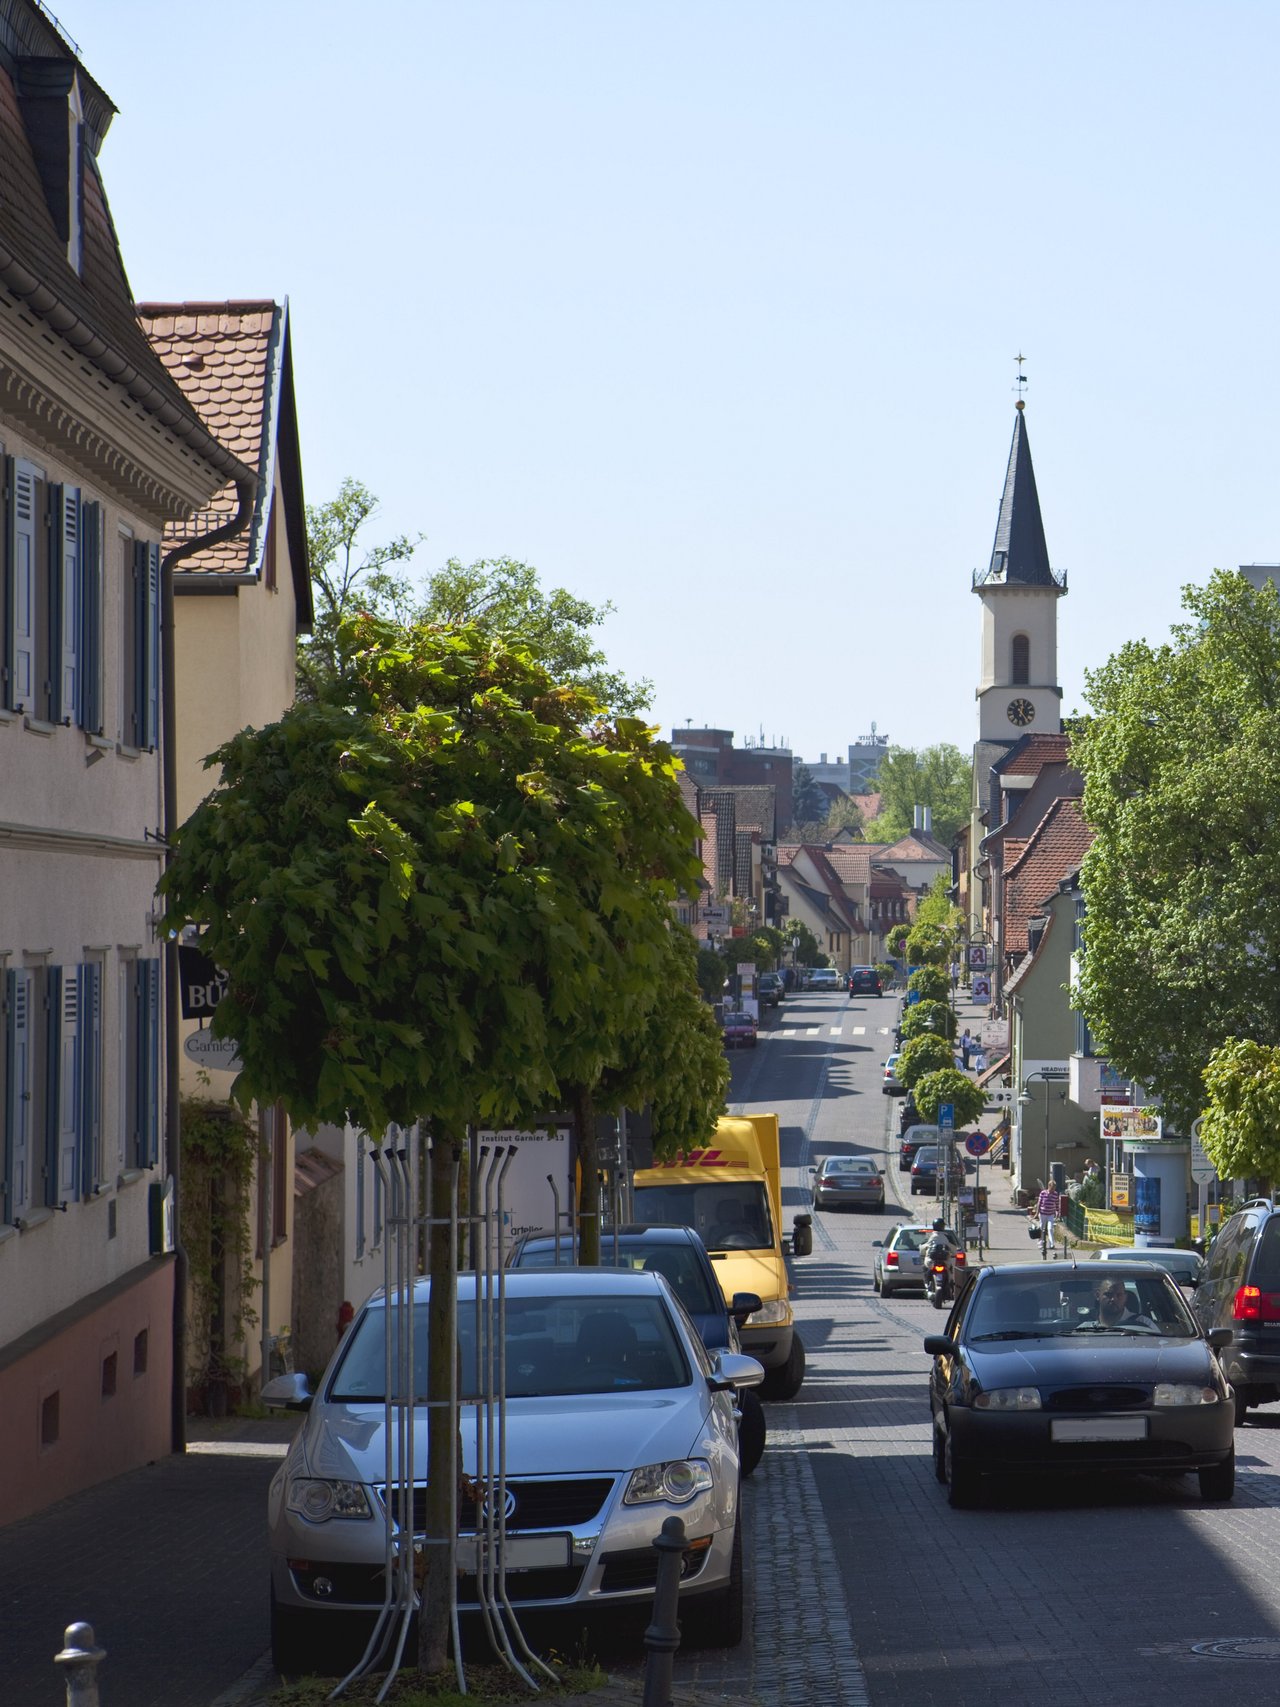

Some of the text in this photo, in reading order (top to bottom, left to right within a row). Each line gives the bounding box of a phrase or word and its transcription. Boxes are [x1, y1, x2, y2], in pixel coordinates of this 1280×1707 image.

[186, 1039, 239, 1053] Garnier
[940, 1105, 948, 1116] P
[514, 1134, 544, 1142] Garnier
